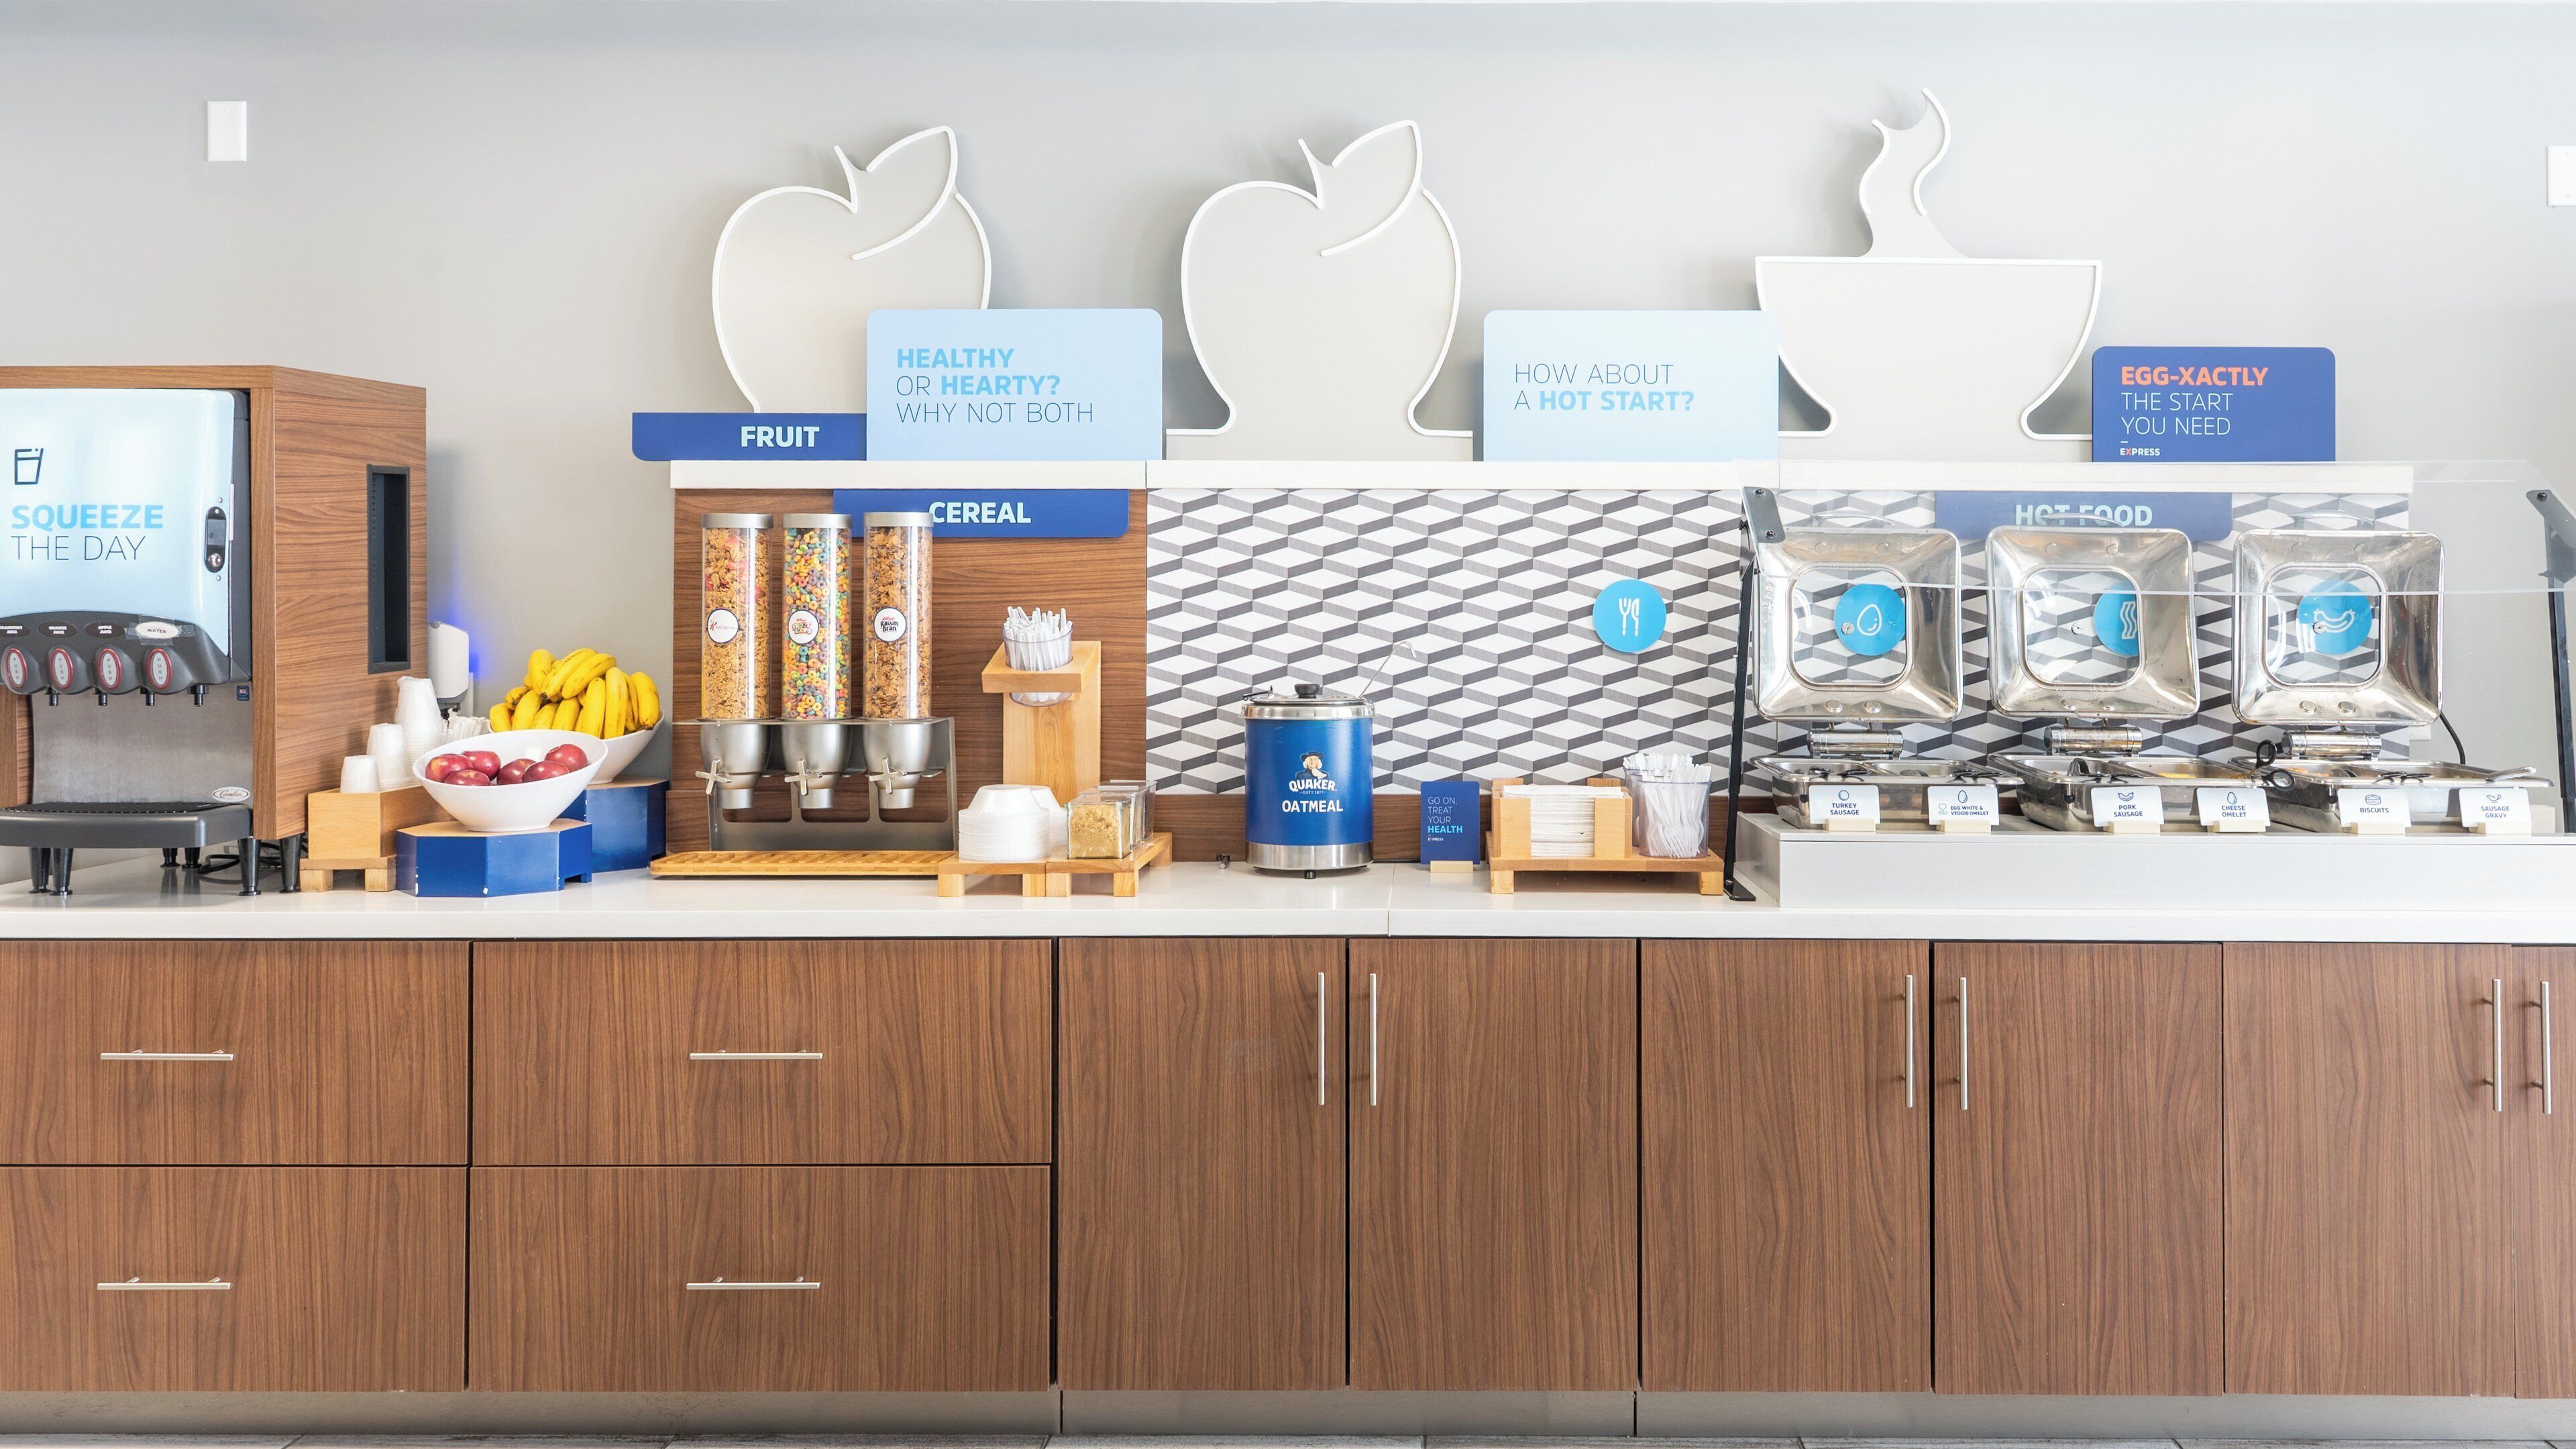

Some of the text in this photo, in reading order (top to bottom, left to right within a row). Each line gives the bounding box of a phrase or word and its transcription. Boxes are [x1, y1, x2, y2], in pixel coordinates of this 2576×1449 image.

[897, 348, 1015, 368] HEALTHY
[1515, 364, 1674, 384] HOW ABOUT
[2121, 366, 2269, 386] EGG-XACTLY
[896, 375, 1061, 396] OR HEARTY?
[1514, 390, 1695, 411] A HOT START?
[2121, 392, 2233, 411] THE START
[896, 402, 1092, 423] WHY NOT BOTH
[2121, 417, 2231, 435] YOU NEED
[741, 426, 820, 447] FRUIT
[2120, 447, 2160, 456] EXPRESS
[11, 504, 164, 532] SQUEEZE
[928, 502, 1032, 523] CEREAL
[2015, 504, 2153, 527] HOT FOOD
[11, 536, 146, 560] THE DAY
[1289, 779, 1336, 792] QUAKER
[1282, 800, 1344, 812] OATMEAL
[1428, 796, 1458, 805] GO ON,
[1428, 816, 1451, 824] YOUR
[1428, 825, 1463, 833] HEALTH
